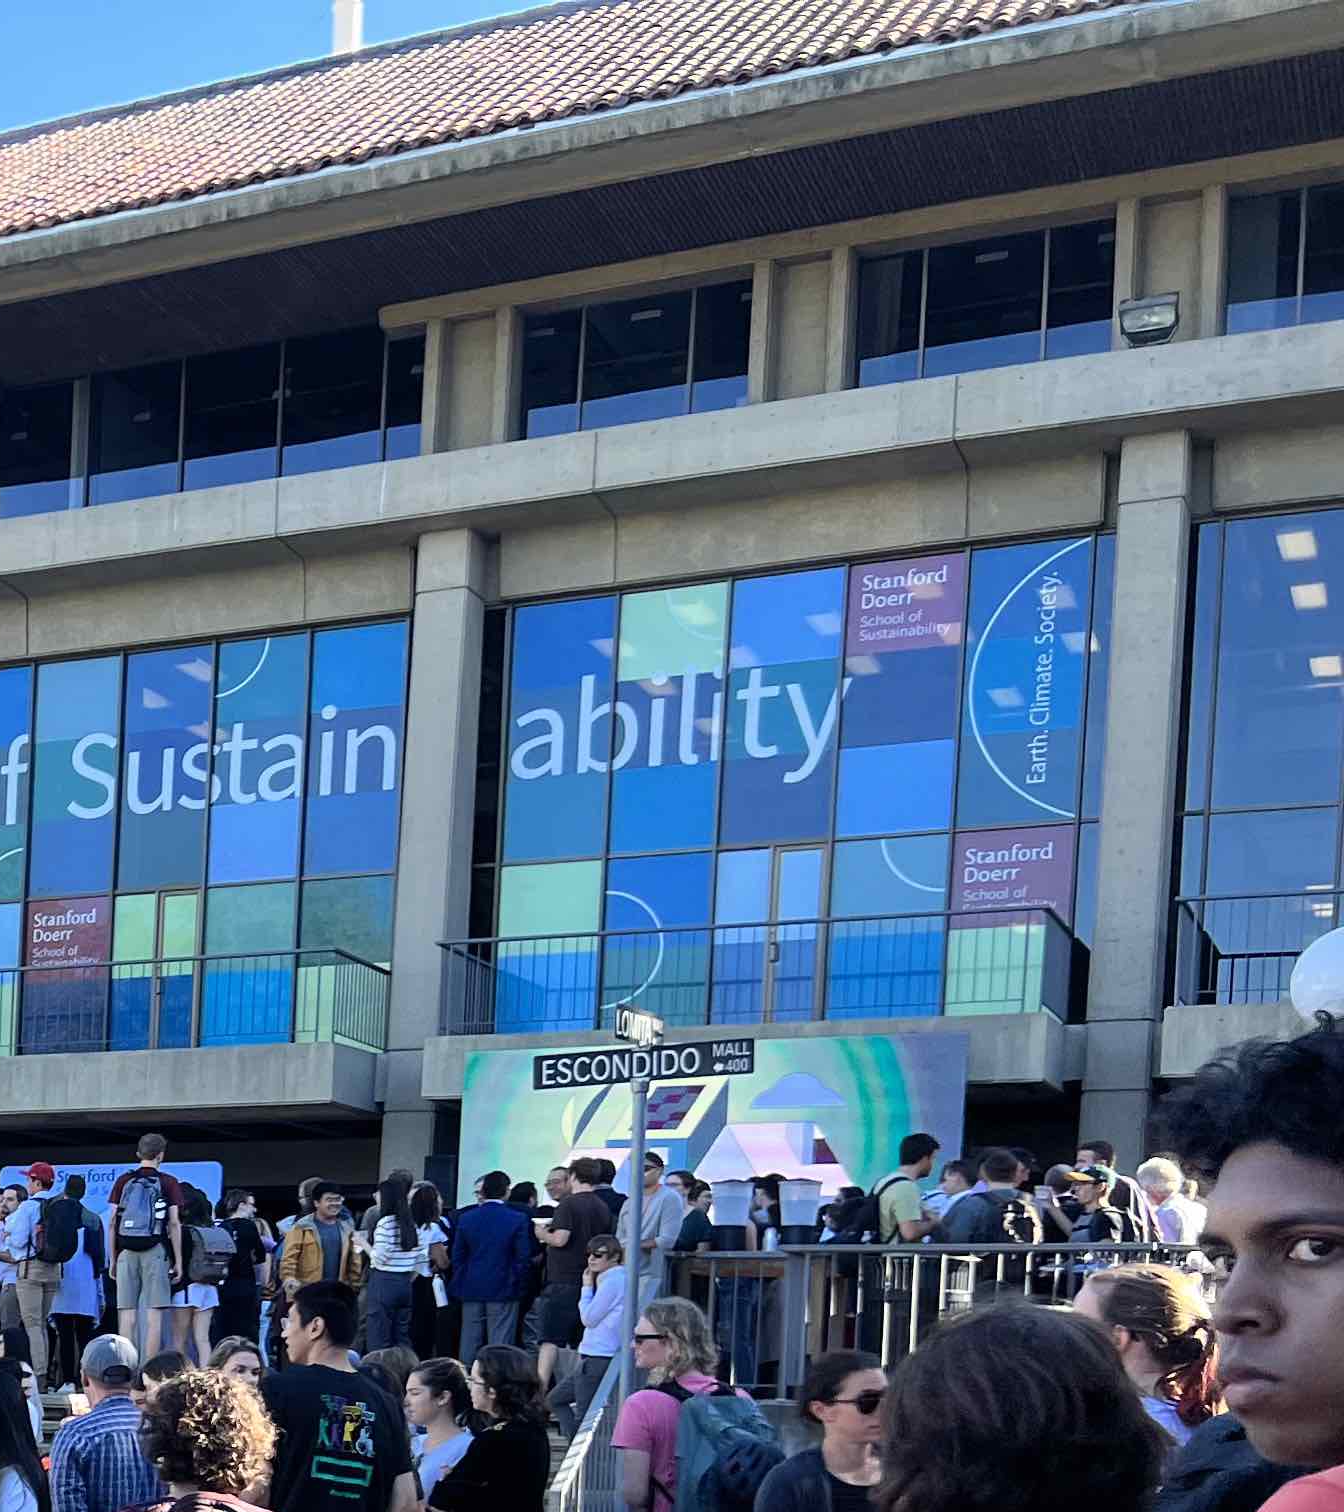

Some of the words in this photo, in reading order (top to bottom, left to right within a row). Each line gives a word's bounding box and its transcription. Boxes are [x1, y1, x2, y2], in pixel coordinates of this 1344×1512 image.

[862, 565, 948, 591] Stanford
[861, 591, 914, 609] Doerr
[1034, 571, 1062, 645] Society.
[860, 611, 905, 627] School
[908, 609, 923, 622] of
[859, 622, 951, 641] Sustainability
[1029, 649, 1054, 726] Climate.
[1025, 730, 1049, 785] Earth.
[964, 841, 1053, 865] Stanford
[963, 867, 1021, 883] Doerr
[962, 886, 1009, 901] School
[1012, 884, 1029, 898] of
[32, 908, 96, 928] Stanford
[32, 929, 73, 943] Doerr
[32, 946, 65, 958] School
[67, 945, 79, 956] of
[541, 1047, 700, 1086] ESCONDIDO
[712, 1043, 751, 1058] MALL
[725, 1058, 749, 1073] 400
